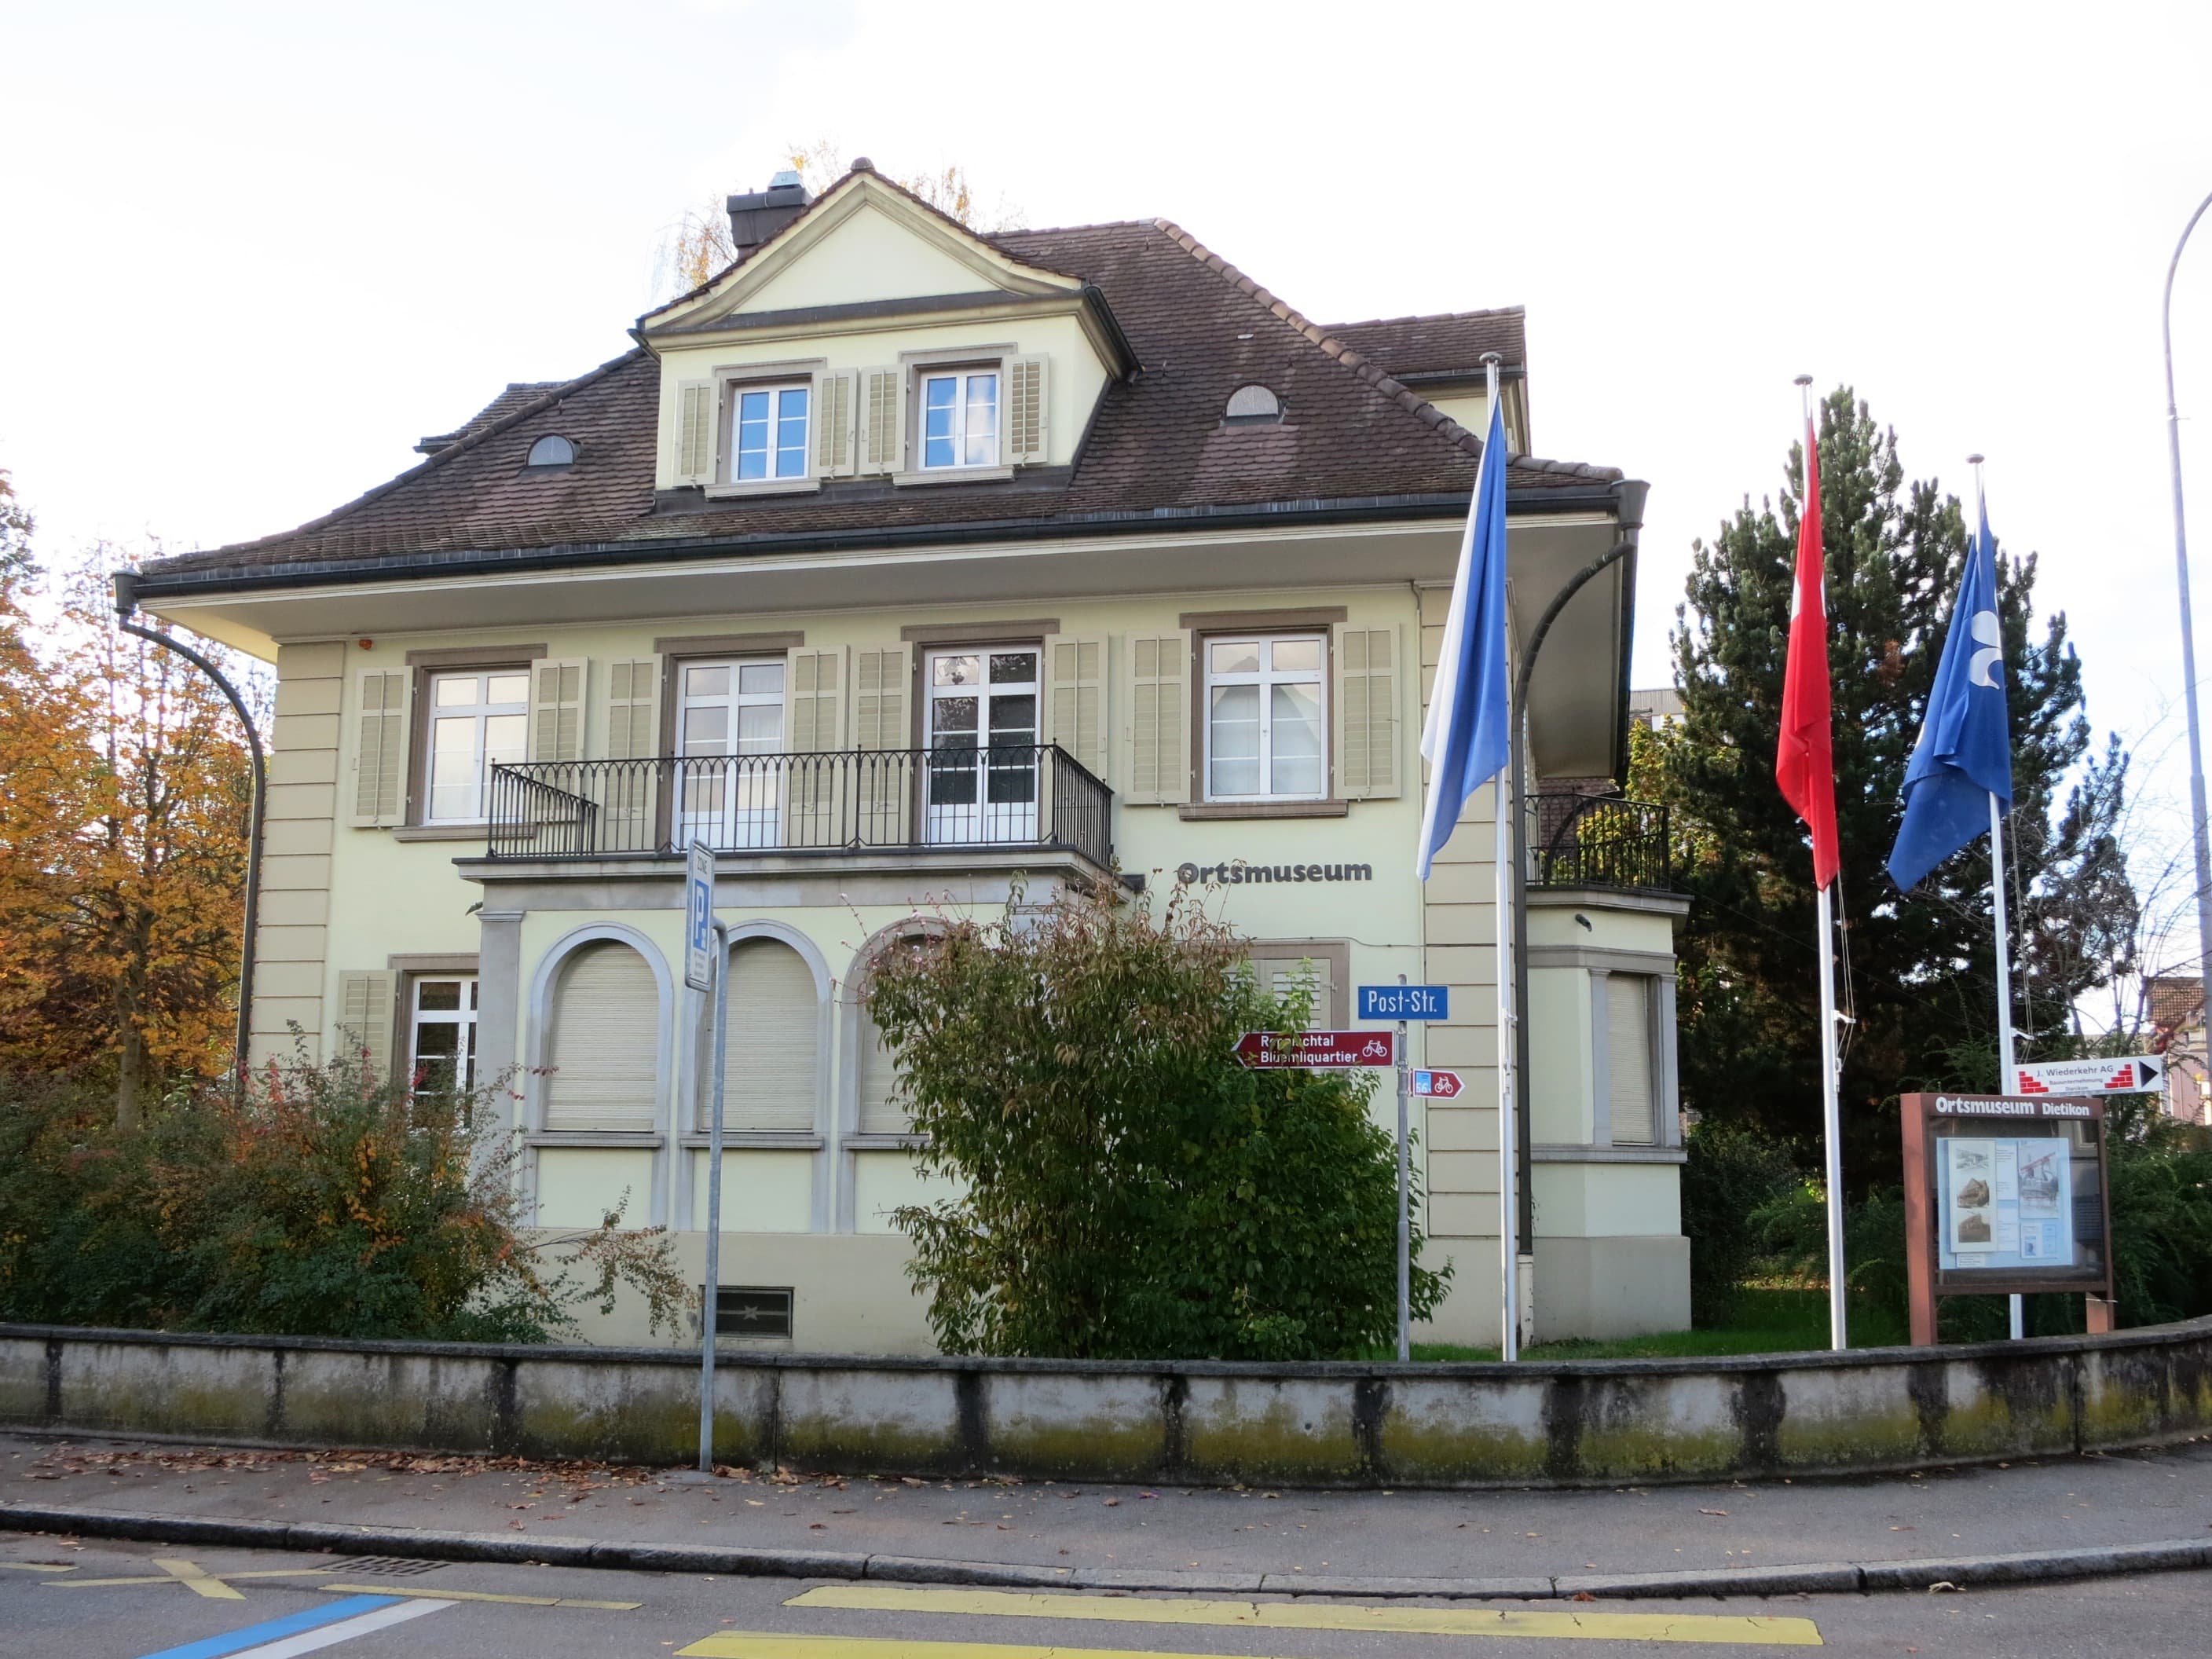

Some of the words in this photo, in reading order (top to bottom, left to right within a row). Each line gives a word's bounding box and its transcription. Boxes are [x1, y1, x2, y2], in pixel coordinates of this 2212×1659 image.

[1177, 862, 1372, 884] Ortsmuseum
[1368, 990, 1437, 1013] Post-Str.
[2045, 1067, 2097, 1077] Wiederkehr
[2100, 1064, 2114, 1074] AG
[1936, 1097, 2034, 1115] Ortsmuseum
[2042, 1102, 2090, 1116] Dietikon
